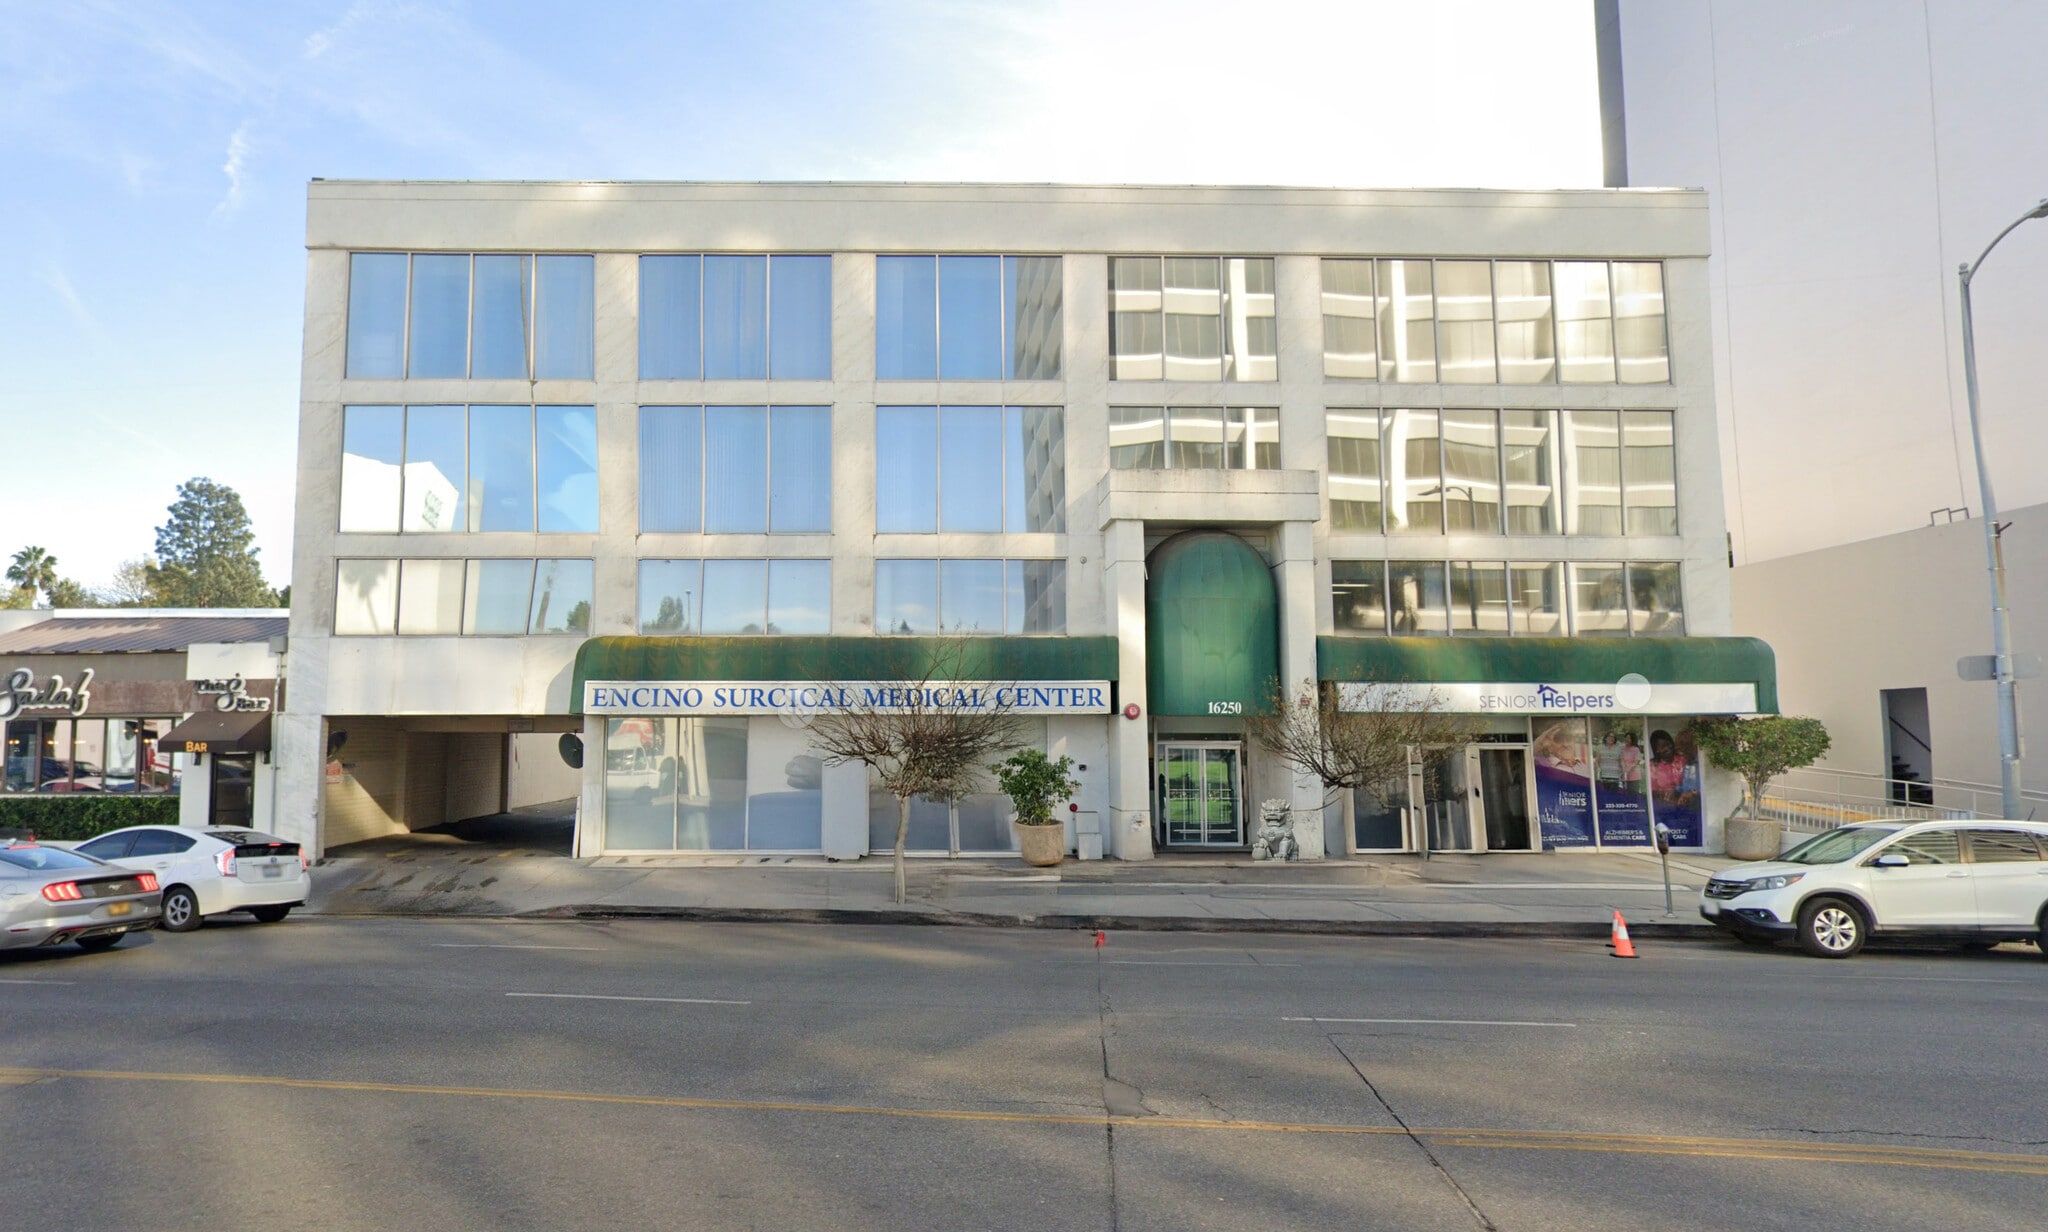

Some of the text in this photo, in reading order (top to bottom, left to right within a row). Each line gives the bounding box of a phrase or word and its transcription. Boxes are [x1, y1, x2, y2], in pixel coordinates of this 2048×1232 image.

[0, 668, 94, 720] Sadaf
[236, 696, 270, 712] Bar
[592, 687, 703, 707] ENCINO
[862, 687, 986, 707] MEDICAL
[996, 687, 1105, 707] CENTER
[1480, 690, 1614, 711] SENIOR Helpers
[1208, 701, 1242, 714] 16250
